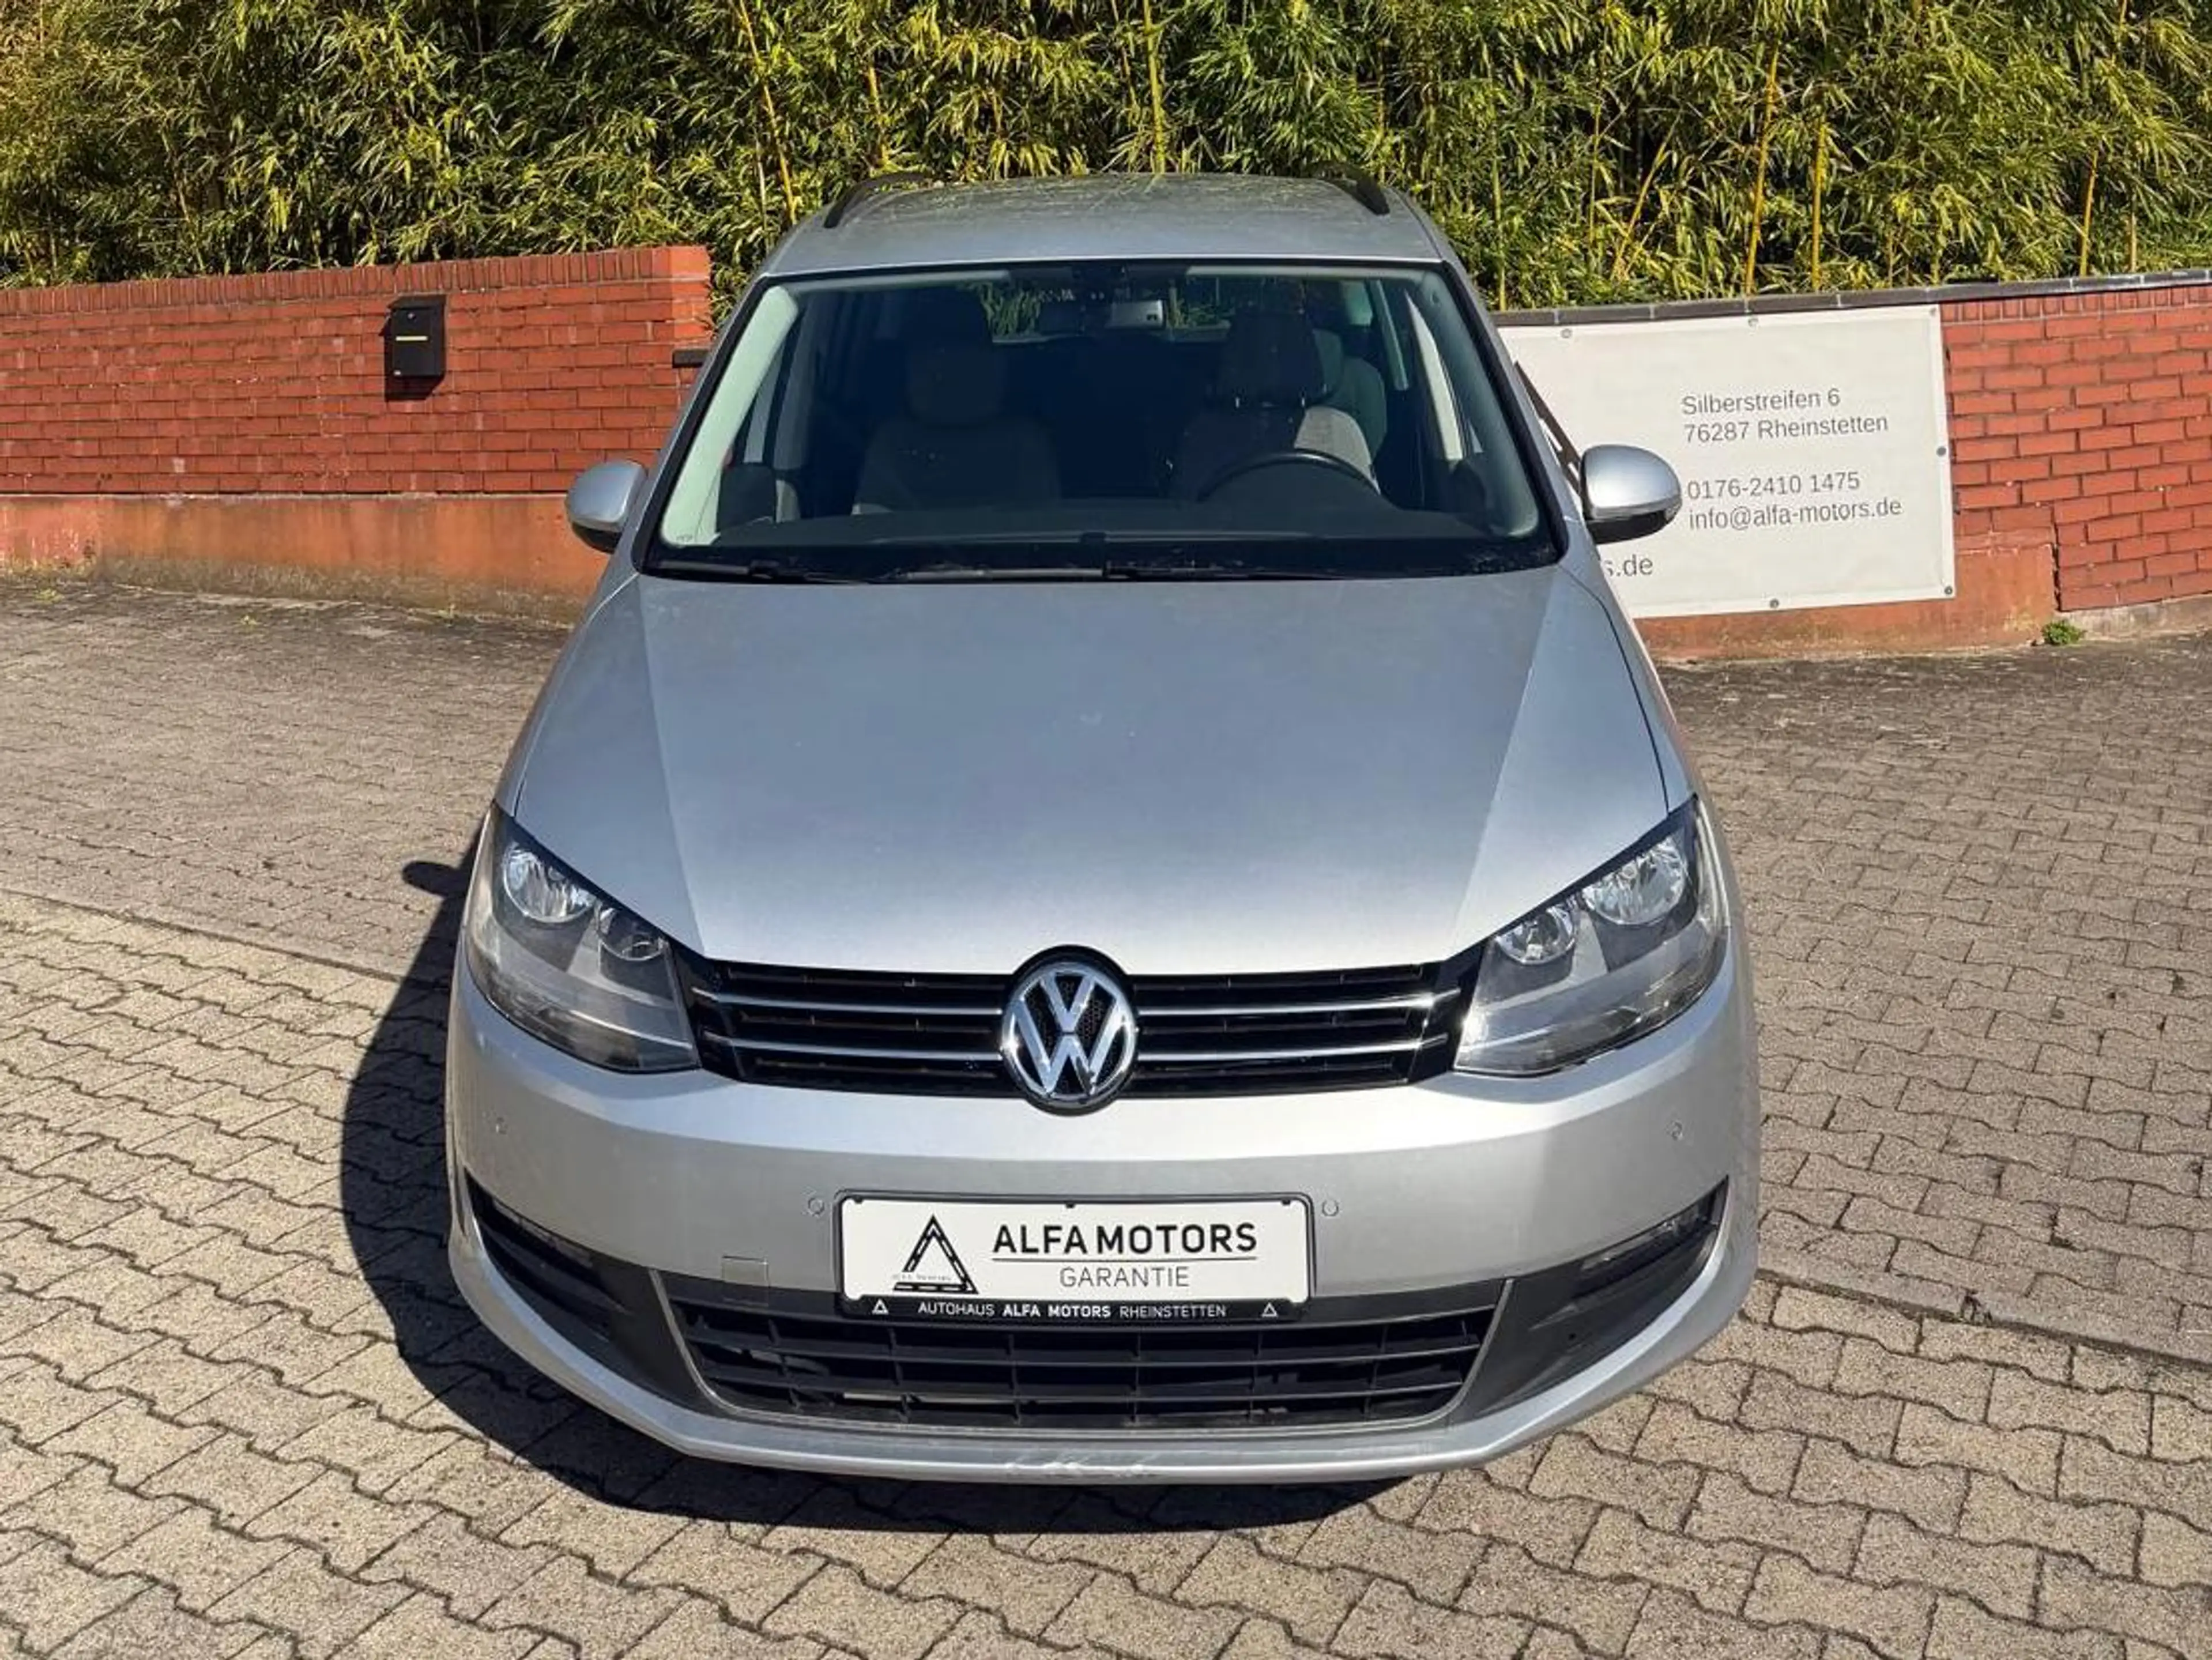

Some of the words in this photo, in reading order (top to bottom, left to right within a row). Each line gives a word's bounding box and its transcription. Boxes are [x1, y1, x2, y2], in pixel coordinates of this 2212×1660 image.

[1682, 390, 1821, 415] Silberstreifen
[1827, 388, 1841, 406] 6
[1684, 421, 1749, 443] 76287
[1757, 417, 1889, 439] Rheinstetten
[1687, 475, 1802, 500] 0176-2410
[1810, 471, 1860, 493] 1475
[1689, 497, 1902, 531] info@alfa-motors.de
[1006, 966, 1133, 1102] VW
[992, 1224, 1088, 1254] ALFA
[1096, 1222, 1257, 1254] MOTORS
[1059, 1266, 1190, 1288] GARANTIE
[917, 1301, 996, 1316] AUTOHAUS
[1002, 1303, 1041, 1317] ALFA
[1047, 1304, 1111, 1318] MOTORS
[1119, 1304, 1227, 1319] RHEINSTETTEN
